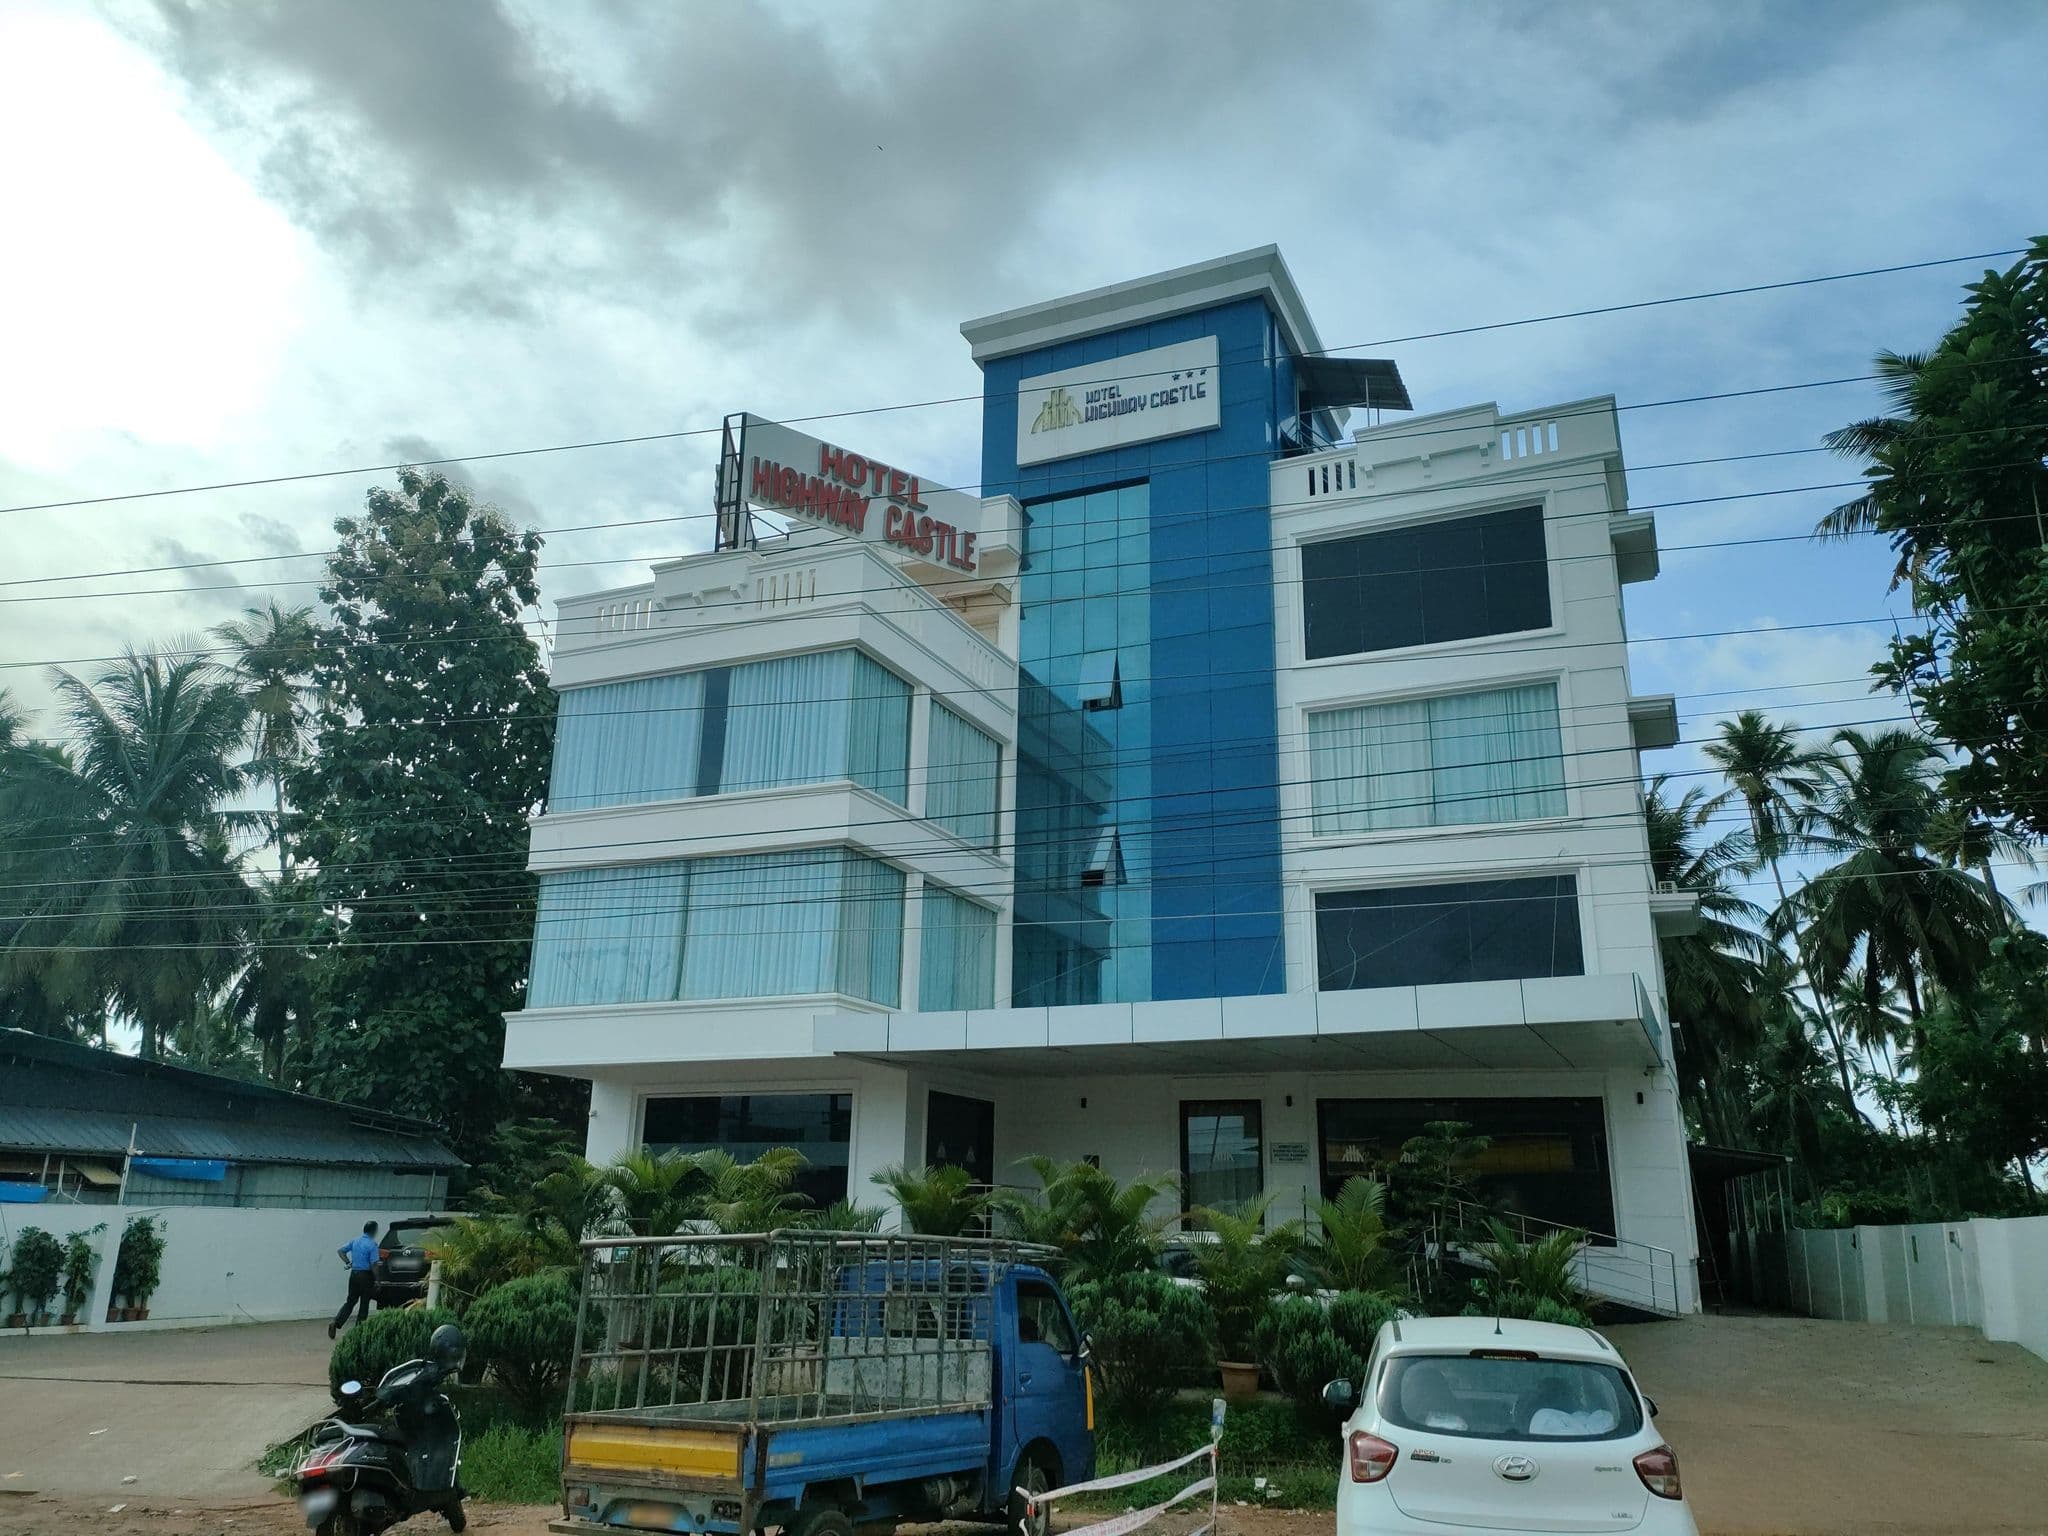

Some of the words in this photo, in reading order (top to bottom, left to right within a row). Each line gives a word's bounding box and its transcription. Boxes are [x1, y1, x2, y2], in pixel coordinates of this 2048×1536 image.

[1085, 395, 1147, 422] HIGHWAY
[1150, 382, 1206, 408] CASTLE
[1086, 385, 1121, 404] HOTEL
[819, 443, 928, 511] HOTEL
[751, 456, 871, 534] HIGHWAY
[883, 504, 977, 571] CASTLE
